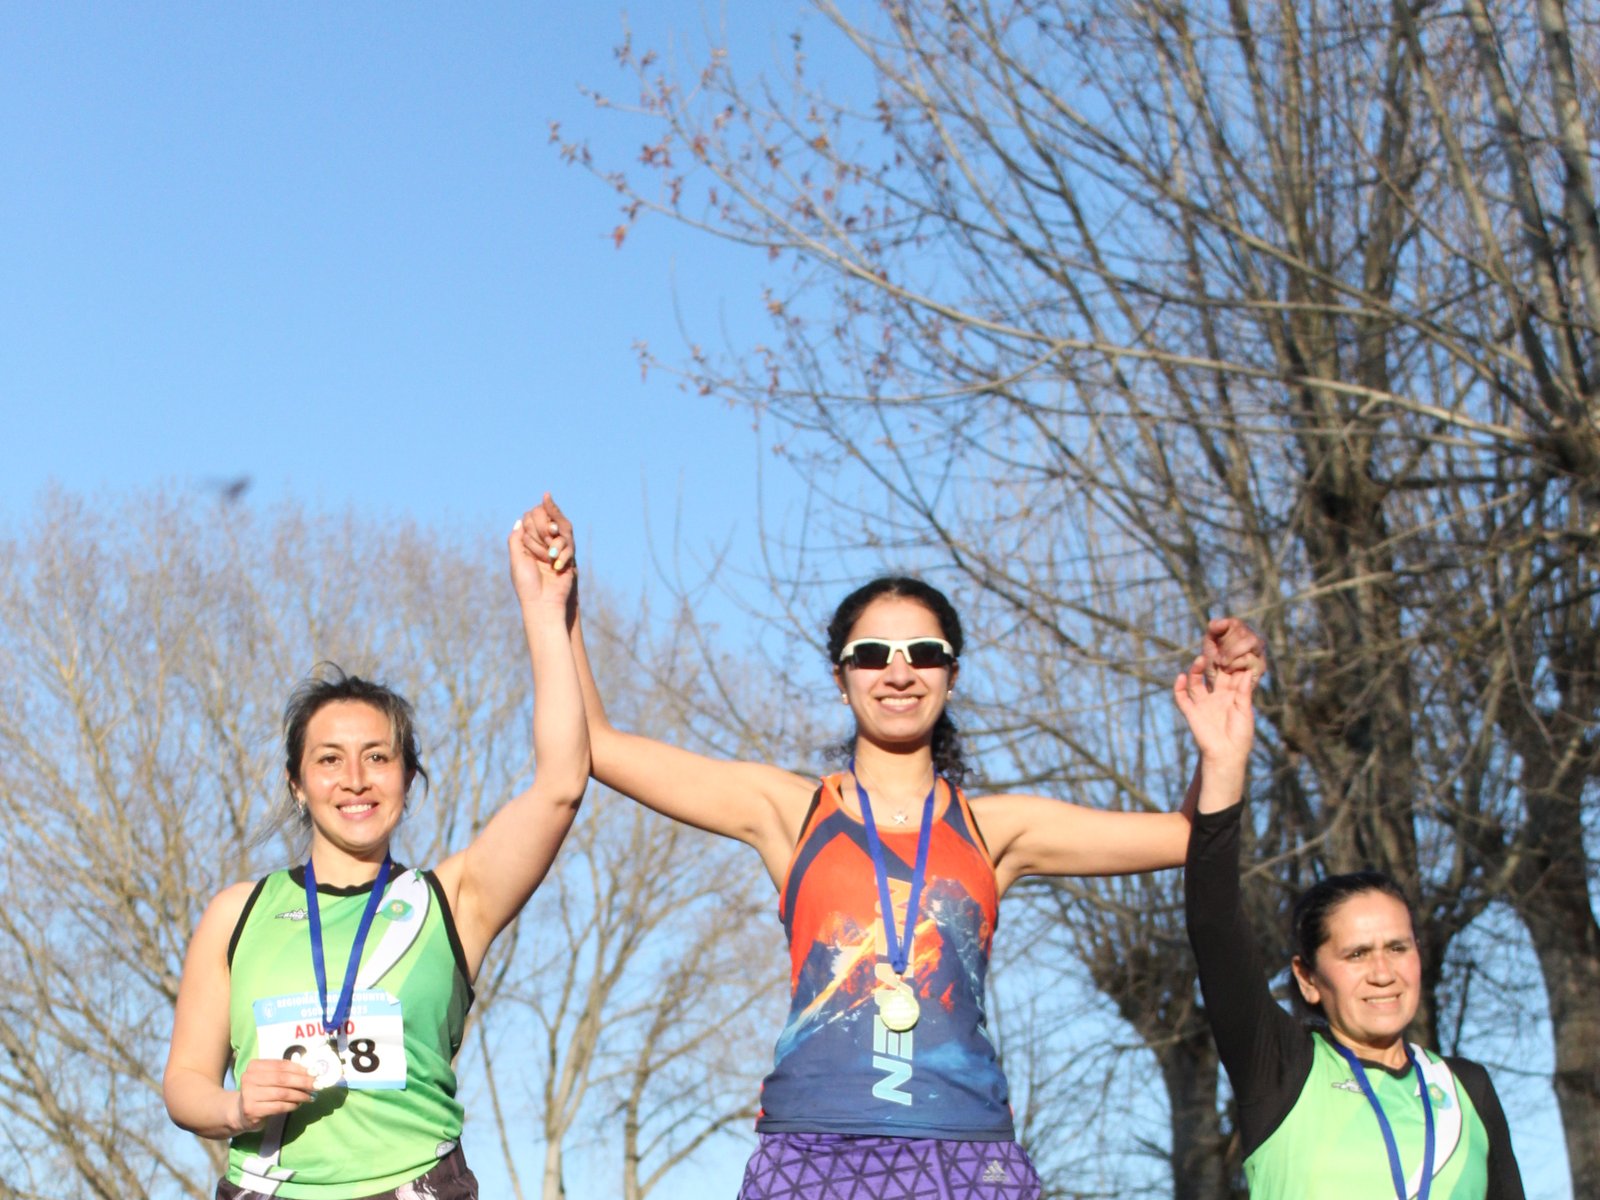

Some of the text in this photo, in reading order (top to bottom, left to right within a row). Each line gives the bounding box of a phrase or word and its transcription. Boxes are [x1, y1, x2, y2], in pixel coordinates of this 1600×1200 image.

[352, 992, 387, 1002] COUNTR
[351, 1005, 369, 1015] 025
[295, 1020, 356, 1039] ADUO
